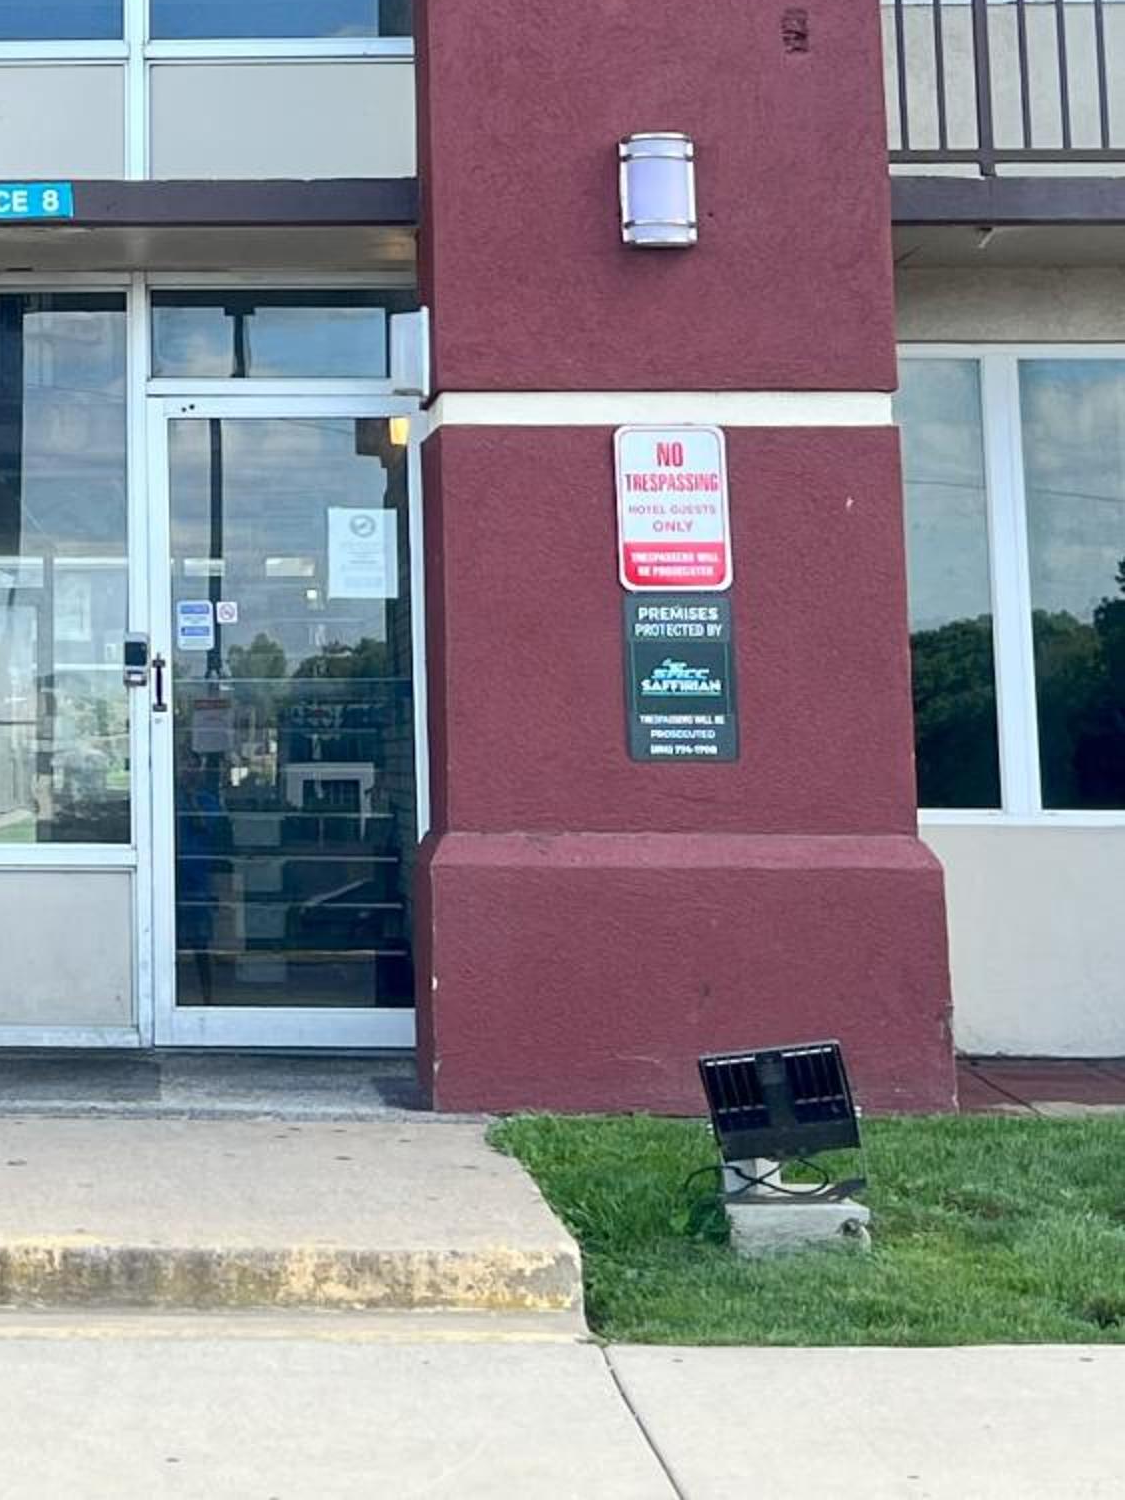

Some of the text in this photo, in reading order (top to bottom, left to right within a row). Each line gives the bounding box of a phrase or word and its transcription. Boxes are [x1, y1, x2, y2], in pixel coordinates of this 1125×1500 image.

[42, 190, 59, 212] 8
[656, 442, 684, 467] NO
[625, 473, 720, 493] TRESPASSING
[628, 504, 716, 515] HOTEL GUESTS
[652, 520, 694, 533] ONLY
[638, 607, 719, 621] PREMISES
[634, 623, 722, 638] PROTECTED BY
[650, 729, 716, 739] PROSECUTED
